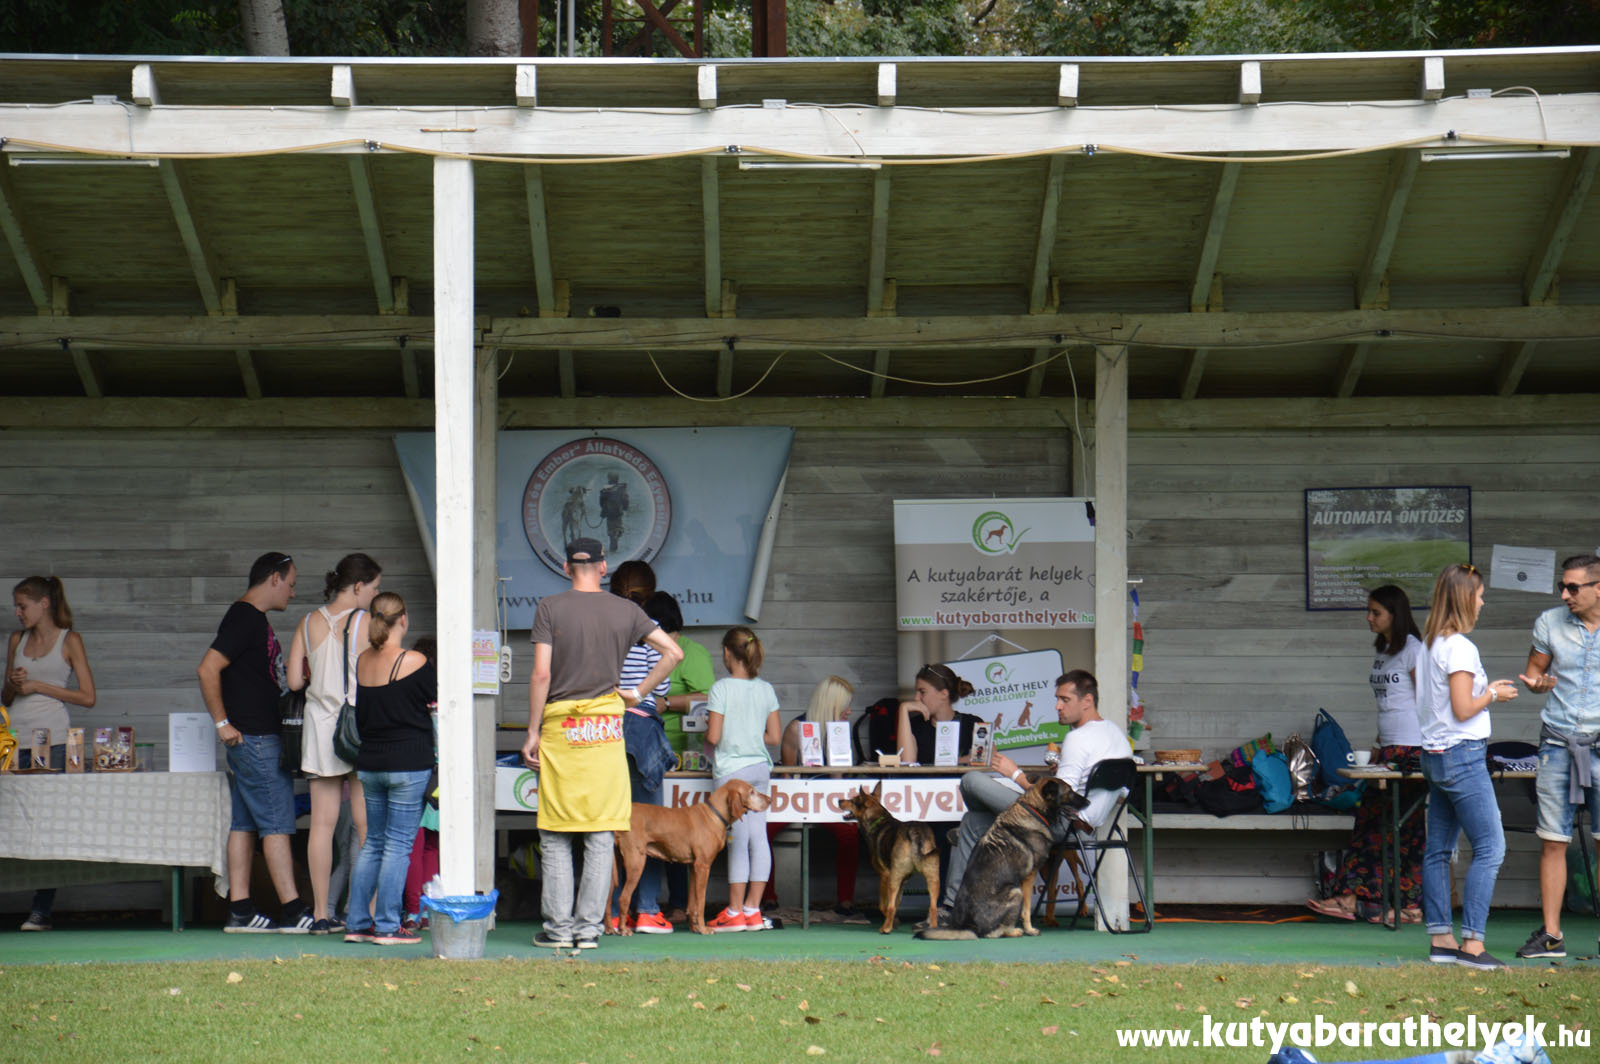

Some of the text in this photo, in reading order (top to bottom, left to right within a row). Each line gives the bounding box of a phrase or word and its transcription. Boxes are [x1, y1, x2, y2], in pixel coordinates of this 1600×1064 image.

[1313, 505, 1465, 525] AUTOMATA ÖNTÖZÉS
[907, 565, 1083, 587] A kutyabarát helyek
[940, 586, 1050, 606] szakértője, a
[901, 609, 1095, 627] www.kutyabarathelyek.hu
[1022, 680, 1049, 691] HELY
[964, 690, 1036, 706] DOGS ALLOWED
